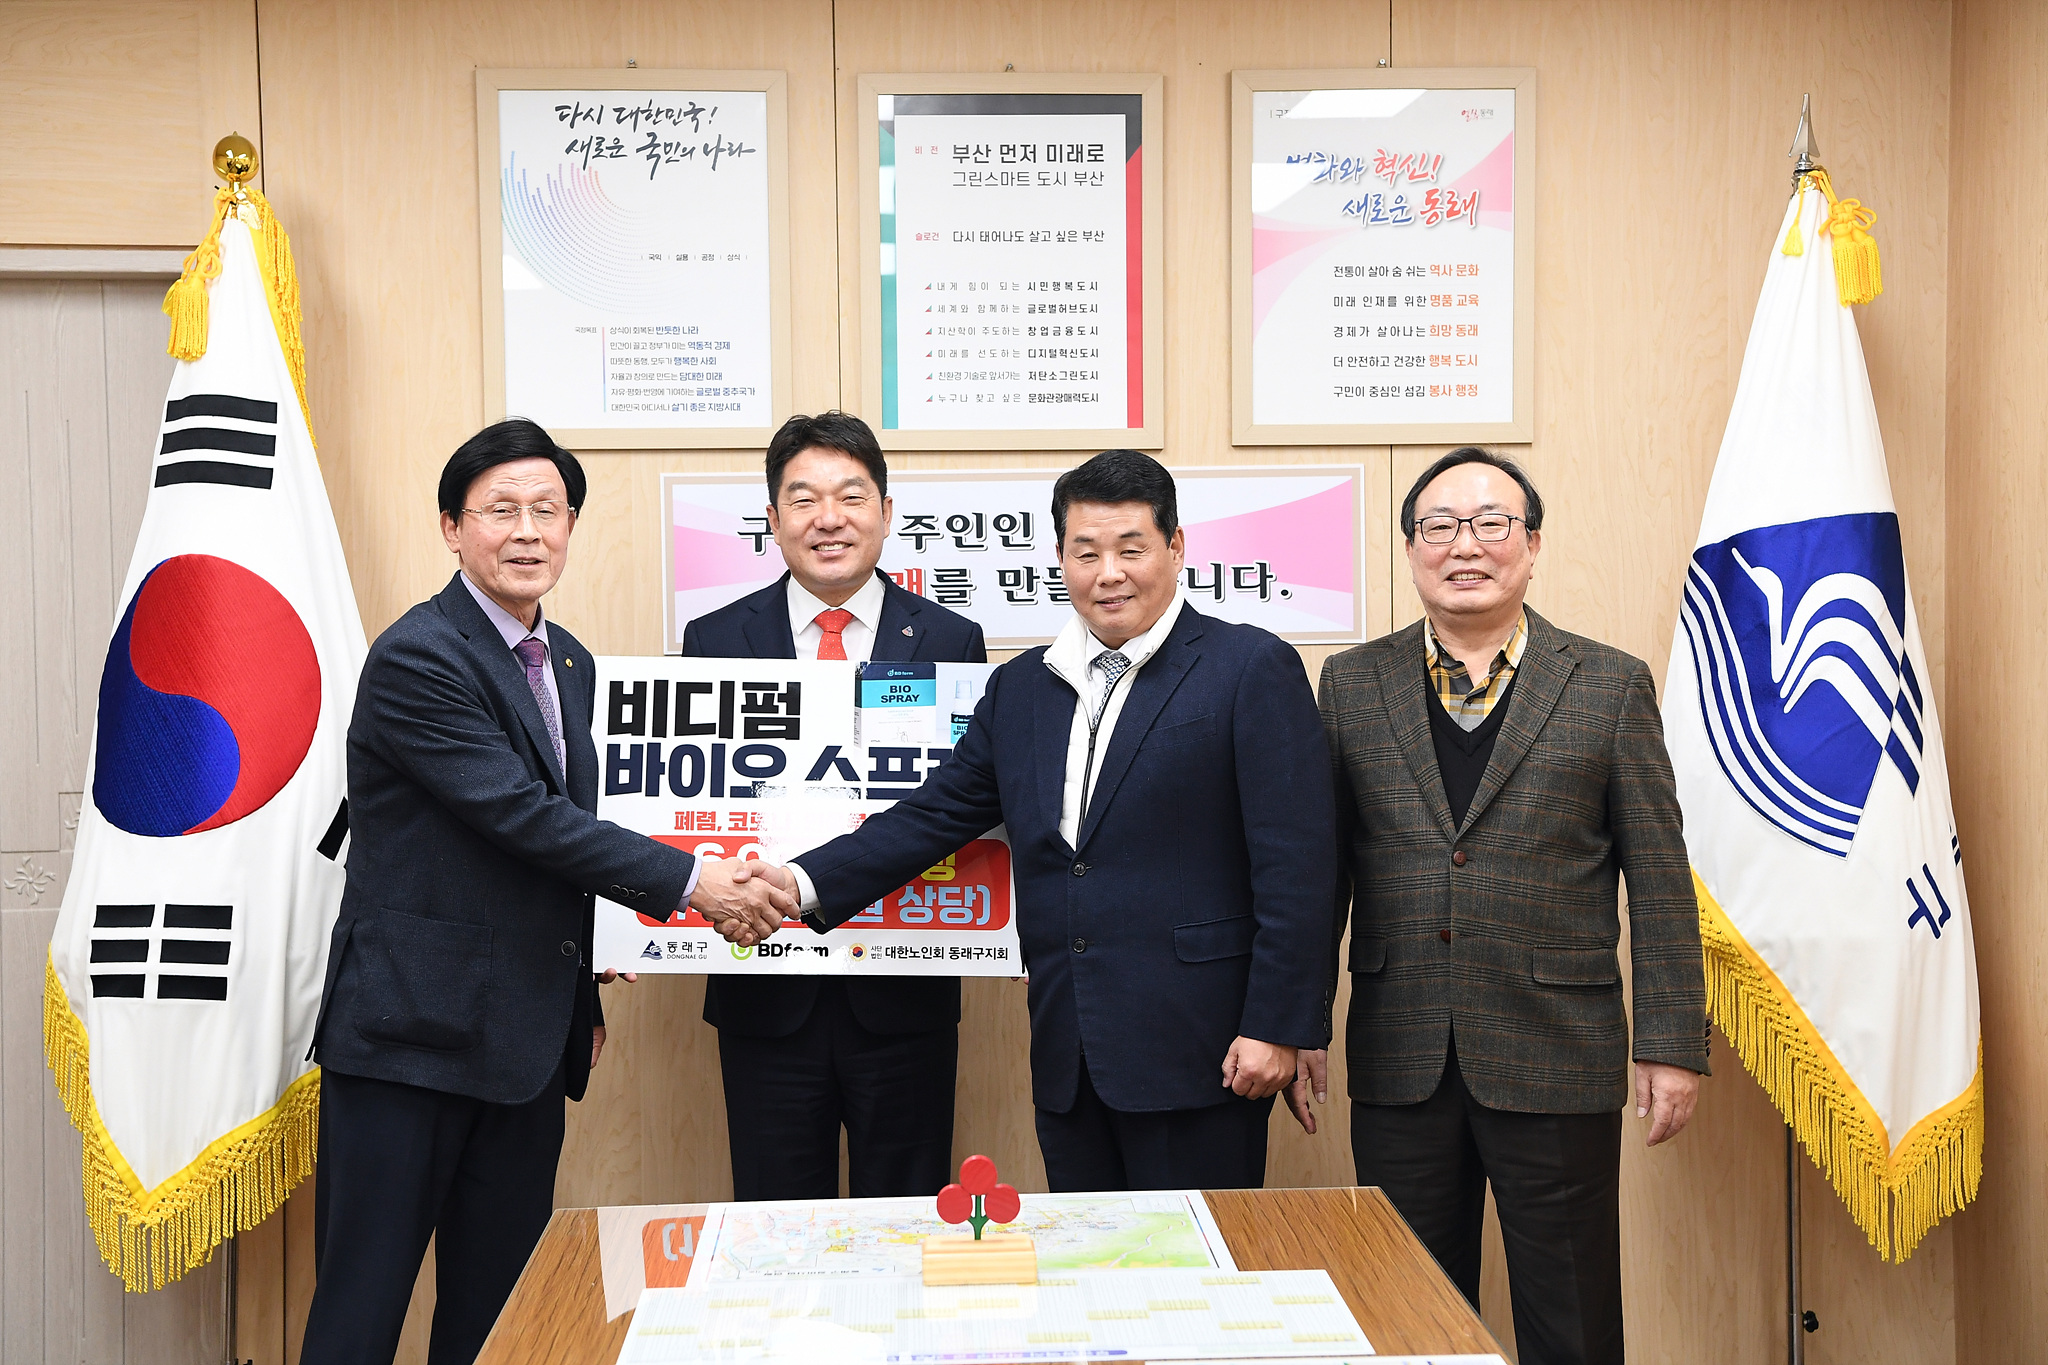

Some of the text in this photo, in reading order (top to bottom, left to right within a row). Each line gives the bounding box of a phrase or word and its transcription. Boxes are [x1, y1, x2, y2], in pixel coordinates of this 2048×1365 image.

[555, 99, 719, 133] 다시 대한민국!
[565, 132, 757, 180] 새로운 국민의 나라
[952, 143, 1105, 164] 부산 먼저 미래로
[1373, 149, 1442, 186] 혁신!
[952, 171, 1104, 187] 그린스마트 도시 부산
[1343, 189, 1478, 226] 새로운 동래
[915, 231, 940, 241] 슬로건
[953, 230, 1105, 243] 다시 태어나도 살고 싶은 부산
[727, 253, 741, 262] 상식
[1333, 265, 1480, 278] 전통이 살아 숨 쉬는 역사 문화
[1333, 294, 1480, 308] 미래 인재를 위한 명품 교육
[937, 303, 1098, 314] 세계와 함께하는 글로벌허브도시
[937, 326, 1099, 336] 지산학이 주도하는 창업금융도시
[1333, 324, 1479, 338] 경제가 살아나는 희망 동래
[937, 348, 1099, 359] 미래를 선도하는 디지털혁신도시
[1333, 354, 1478, 368] 더 안전하고 건강한 행복 도시
[938, 371, 1099, 381] 친환경 기술로 앞서가는 저탄소그린도시
[938, 393, 1099, 403] 누구나 찾고 싶은 문화관광매력도시
[1333, 384, 1478, 398] 구민이 중심인 섬김 봉사 행정
[898, 511, 1034, 552] 주인인
[888, 566, 976, 606] 래를
[890, 685, 912, 694] BIO
[880, 694, 920, 704] SPRAY
[607, 680, 801, 741] 비디펌
[605, 742, 956, 800] 바이오 스프
[674, 811, 722, 832] 폐렴,
[898, 885, 991, 925] 상당)
[667, 941, 708, 953] 동래구
[885, 946, 1009, 960] 대한노인회 동래구지회
[870, 952, 883, 960] 법인
